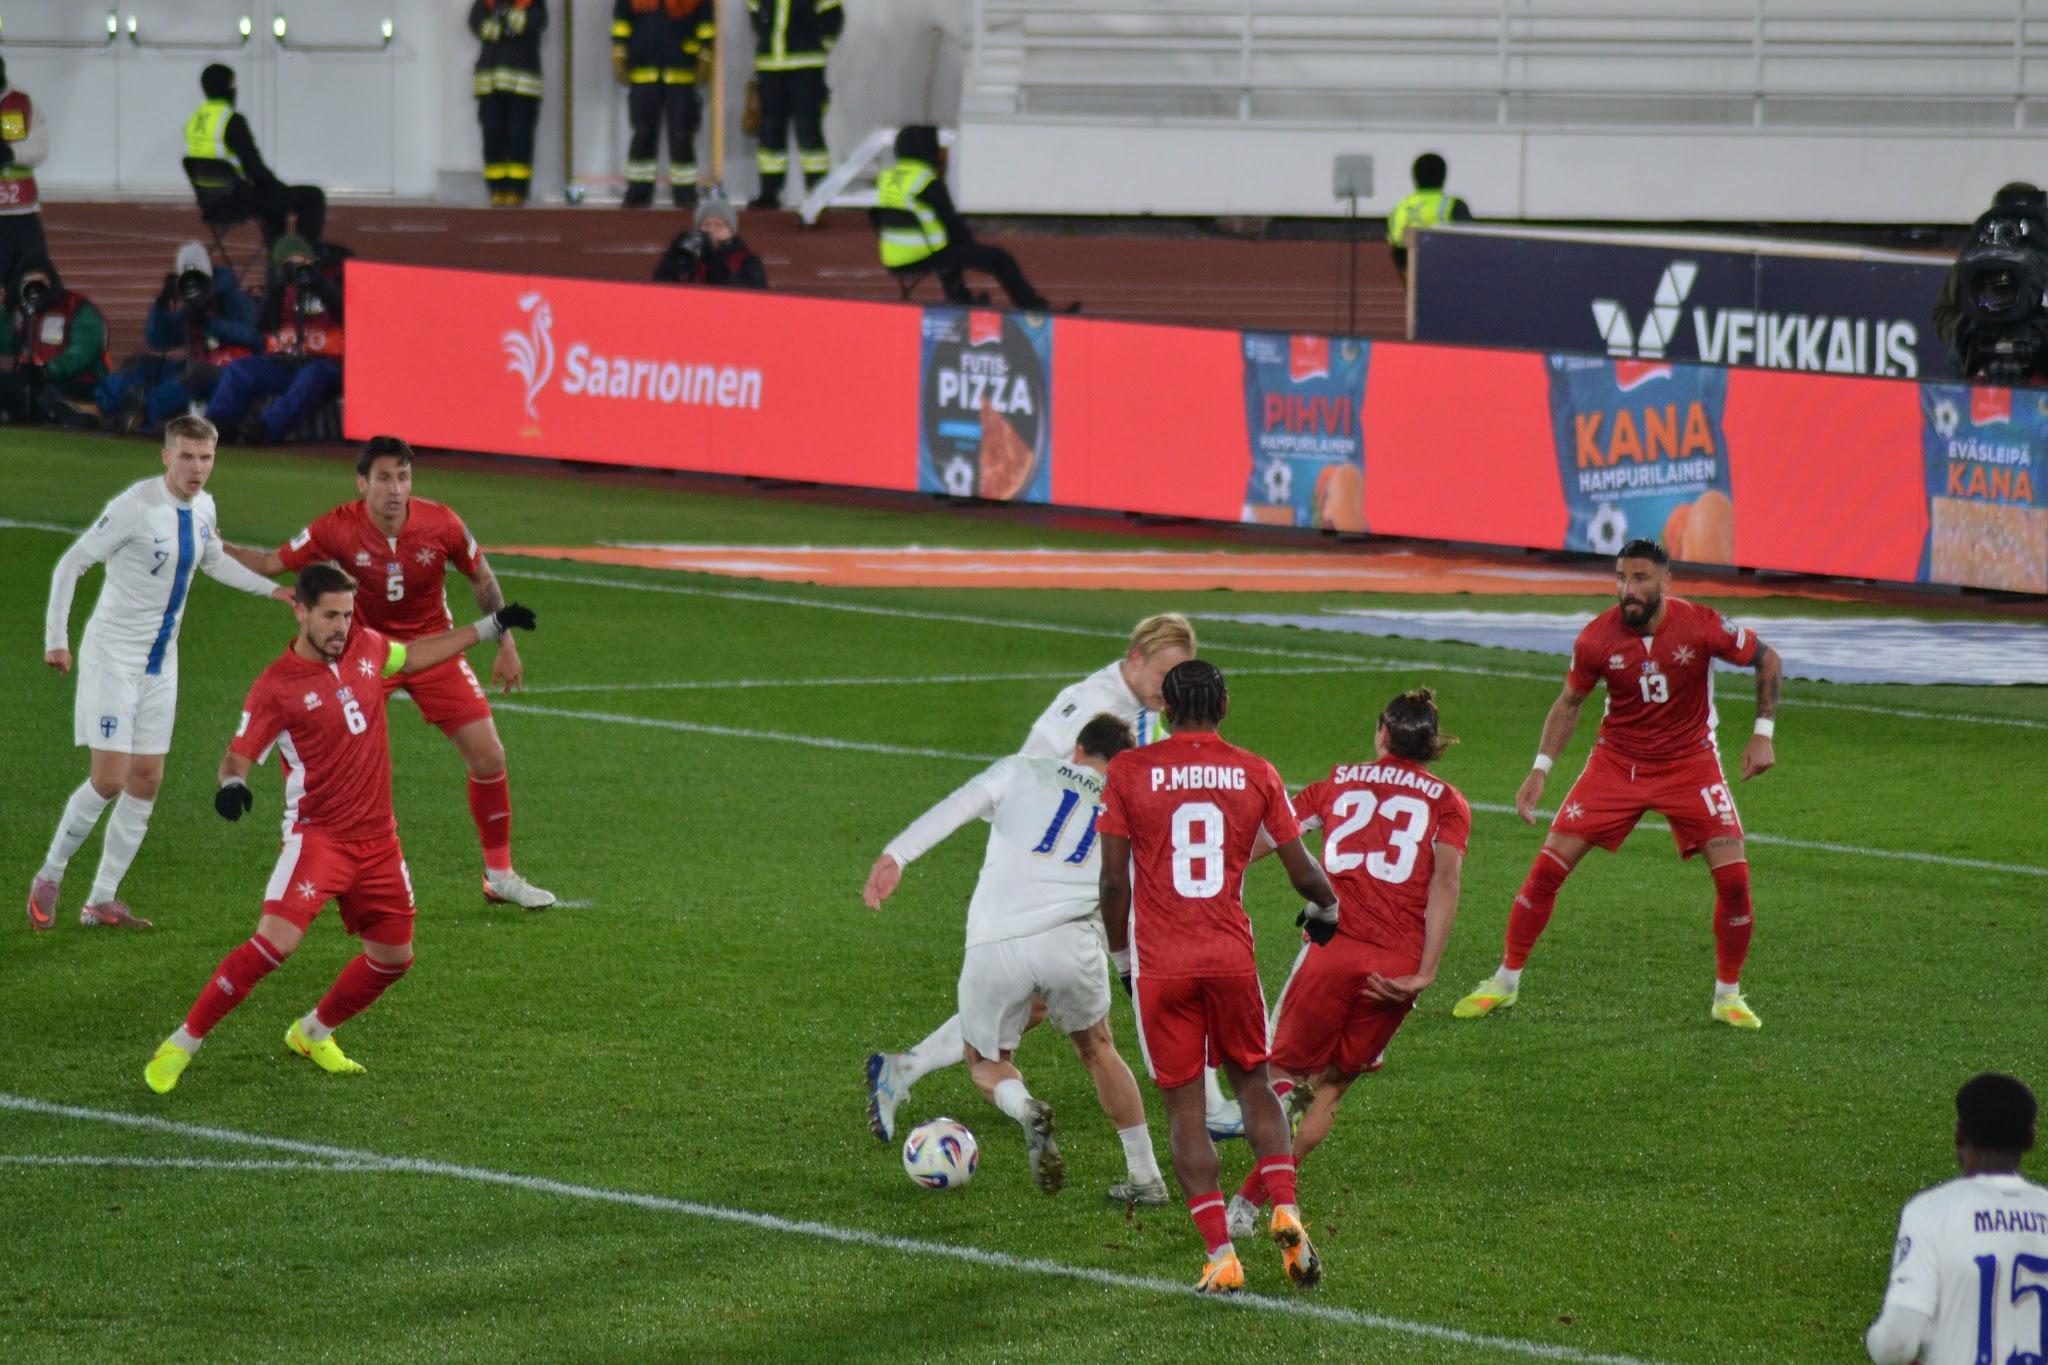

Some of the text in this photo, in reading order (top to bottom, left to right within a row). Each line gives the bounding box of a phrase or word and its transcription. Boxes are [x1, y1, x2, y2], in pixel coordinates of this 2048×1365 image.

[1693, 306, 1918, 378] VEIKKAUS
[563, 342, 762, 409] Saarioinen
[938, 368, 1033, 416] PIZZA
[1264, 393, 1354, 436] PIHVI
[1575, 401, 1715, 469] KANA
[1578, 459, 1717, 493] HAMPURILAINEN
[1947, 462, 2034, 503] KANA
[150, 551, 170, 576] 7
[386, 574, 405, 602] 5
[1638, 673, 1669, 704] 13
[343, 699, 368, 736] 6
[1151, 765, 1247, 792] P.MBONG
[1333, 764, 1446, 800] SATARIANO
[1699, 783, 1733, 817] 13
[1031, 788, 1101, 866] 11
[1324, 788, 1431, 885] 23
[1171, 801, 1226, 899] 8
[1974, 1252, 2048, 1365] 15
